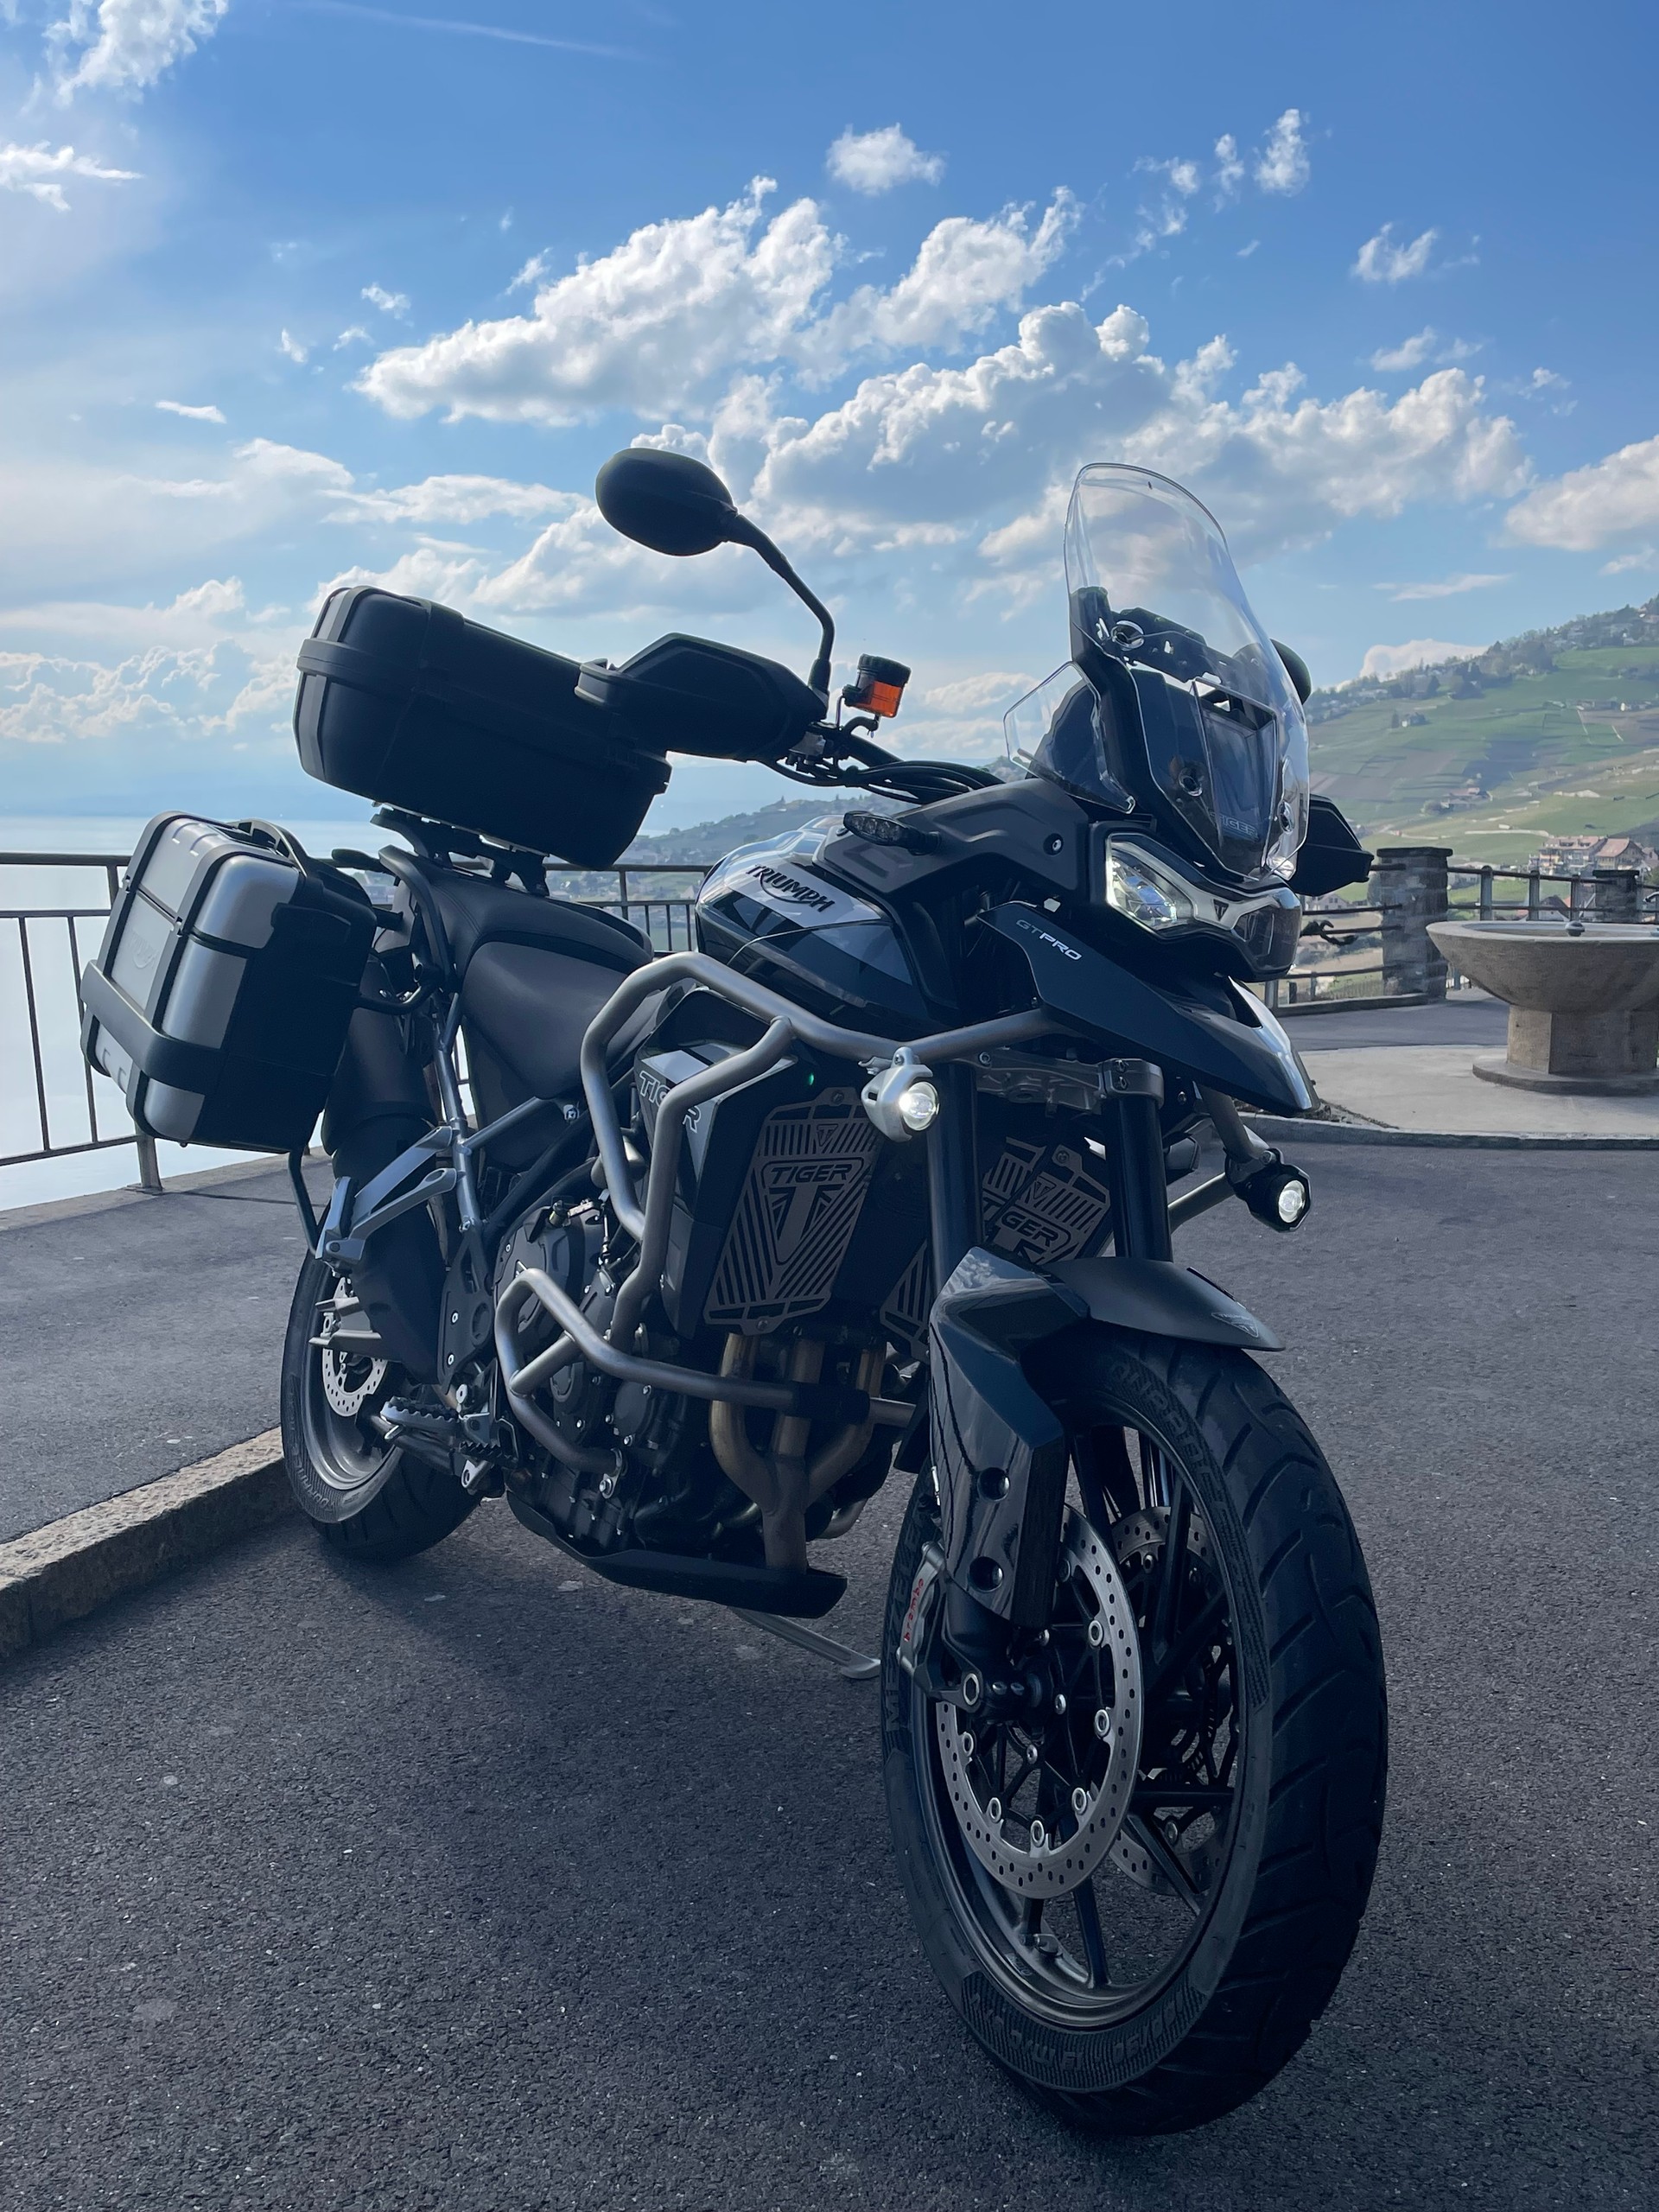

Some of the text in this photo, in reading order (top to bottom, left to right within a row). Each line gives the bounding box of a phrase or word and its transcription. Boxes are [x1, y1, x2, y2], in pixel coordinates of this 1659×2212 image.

[746, 864, 836, 912] TRIUMPH
[639, 1070, 702, 1134] TIR
[771, 1163, 853, 1185] TIGER
[983, 1197, 1059, 1247] TGER
[904, 1578, 925, 1641] brembo
